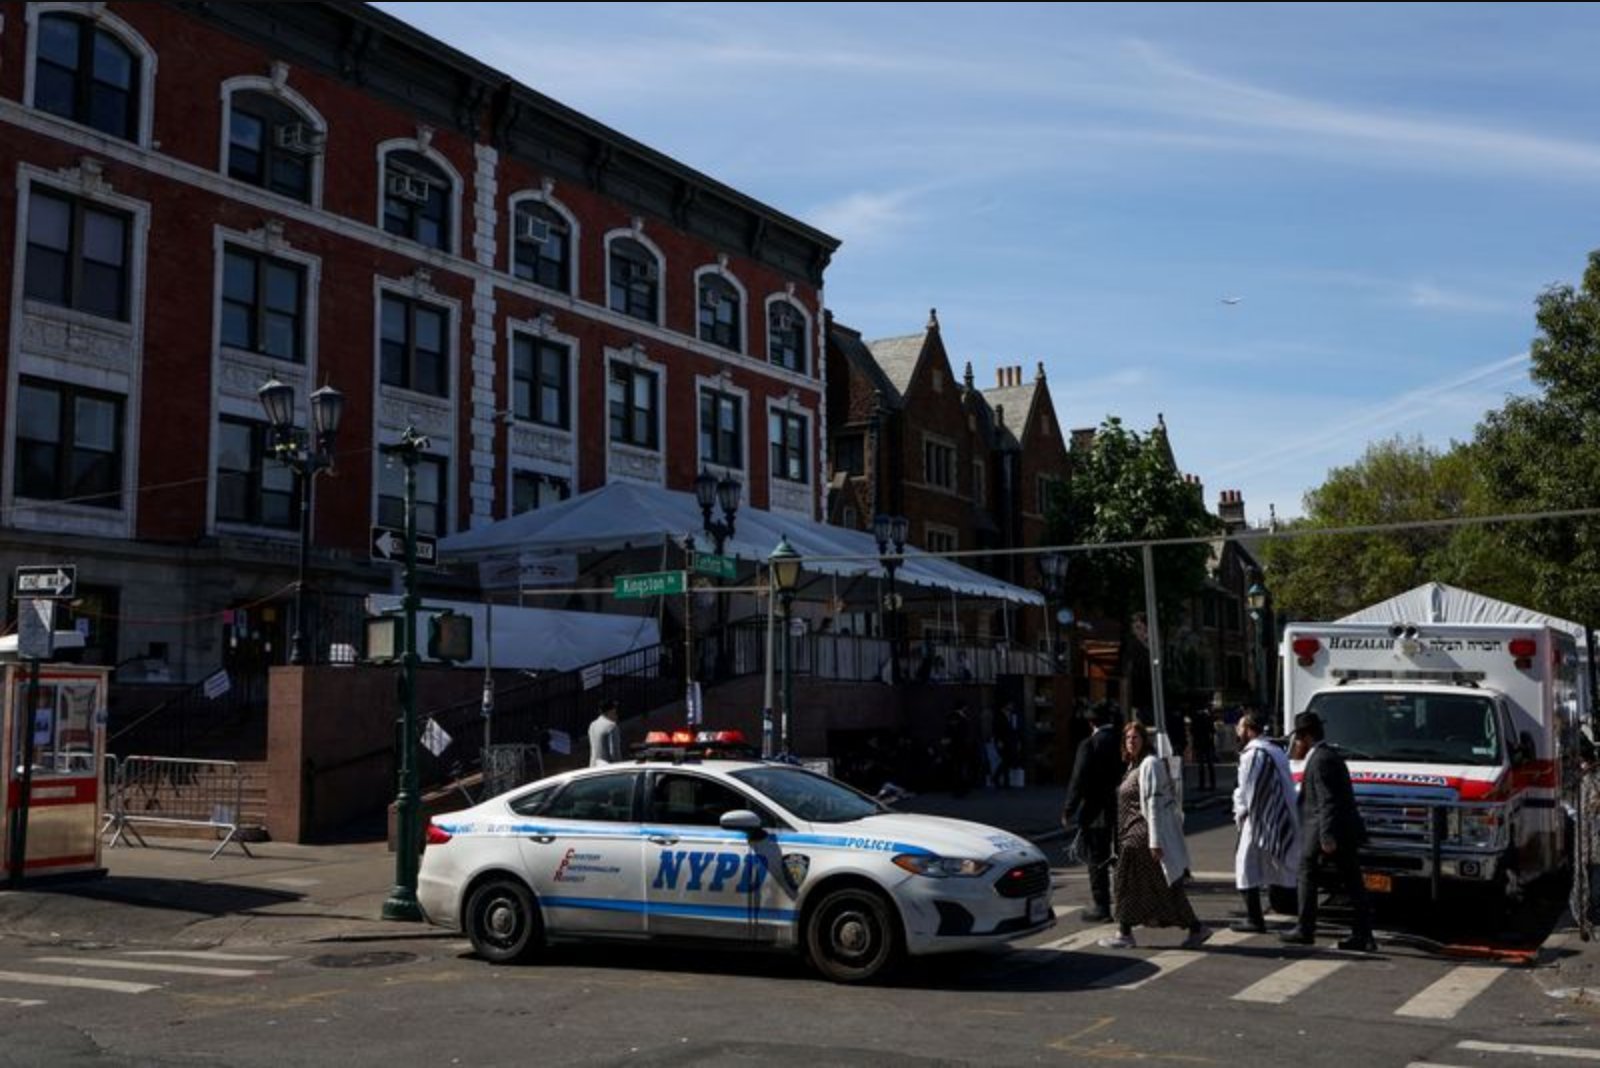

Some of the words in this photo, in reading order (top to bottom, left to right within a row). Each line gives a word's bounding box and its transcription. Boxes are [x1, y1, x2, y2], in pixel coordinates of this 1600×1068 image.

[623, 577, 665, 598] Kingston
[1329, 636, 1395, 650] HATZALAH
[847, 836, 893, 851] POLICE
[653, 850, 769, 893] NYPD
